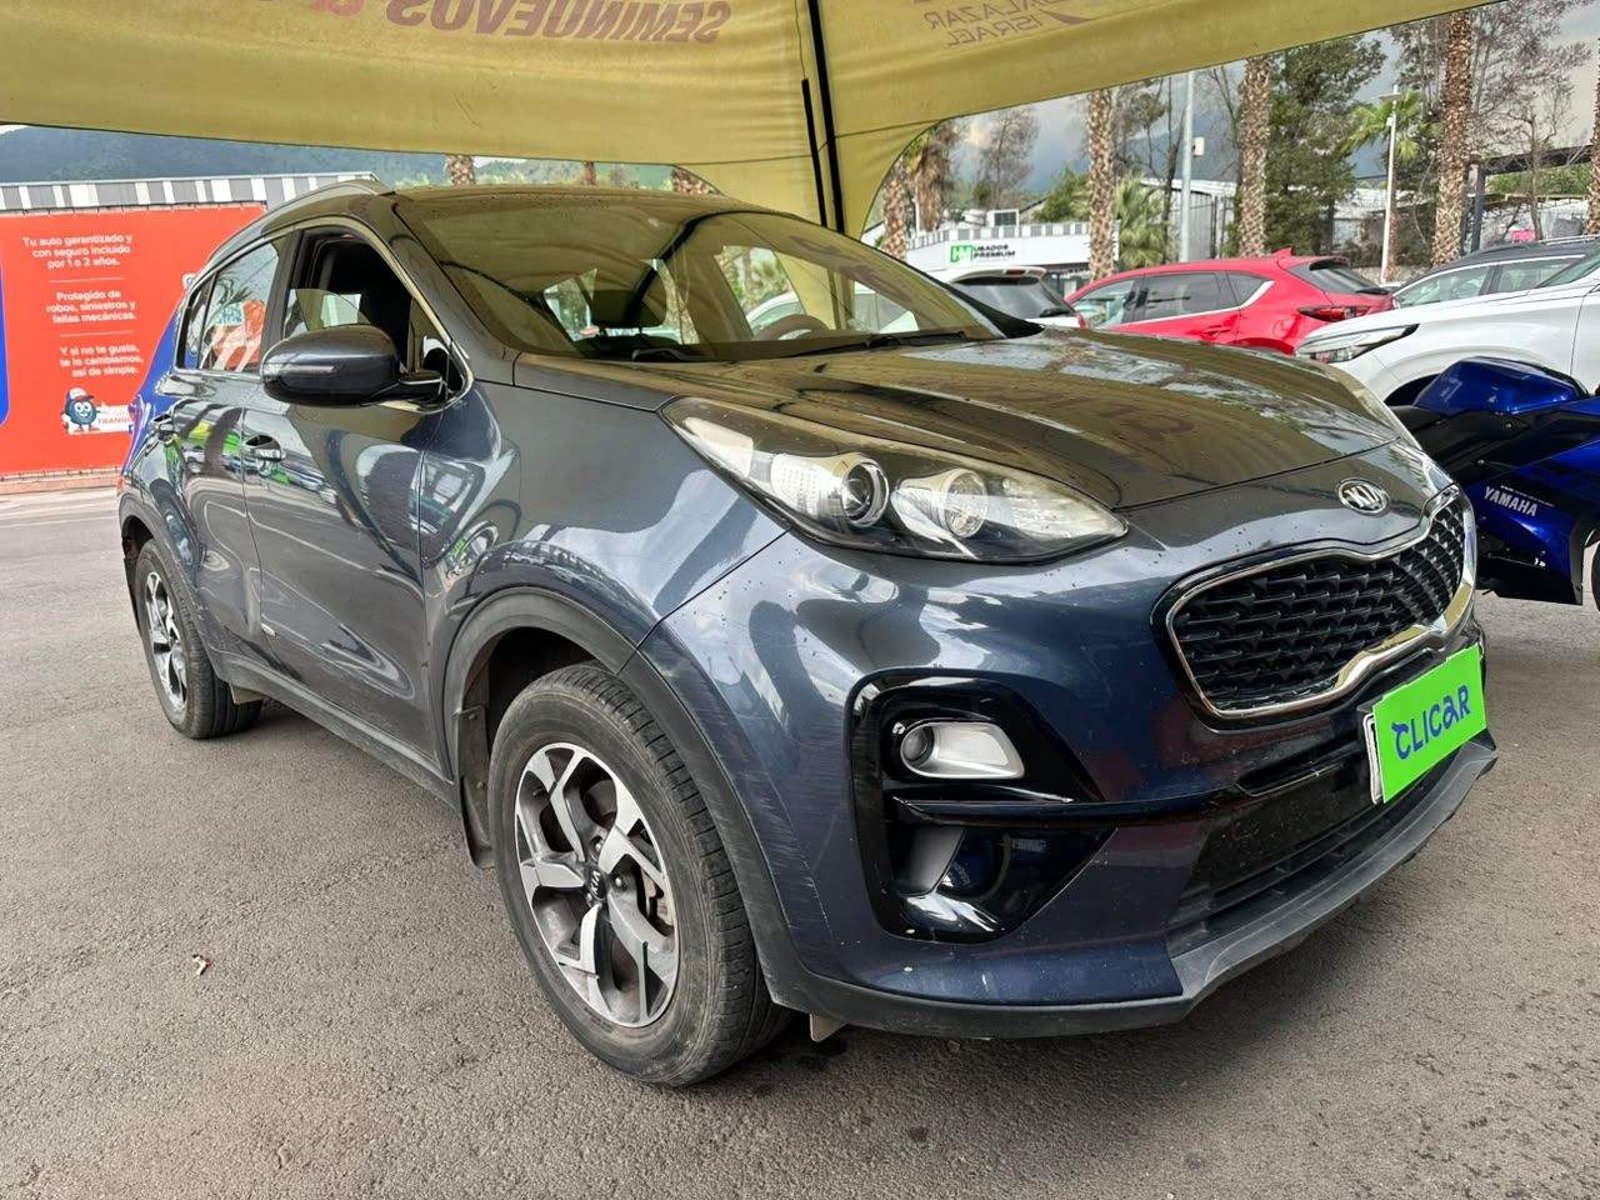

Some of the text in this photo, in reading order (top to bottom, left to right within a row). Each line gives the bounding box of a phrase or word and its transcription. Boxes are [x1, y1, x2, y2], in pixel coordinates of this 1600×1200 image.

[22, 234, 133, 247] Tu auto garantizado y
[32, 245, 131, 259] con seguro incluido
[48, 259, 65, 270] por
[83, 256, 91, 267] 2
[56, 290, 121, 302] Protegido de
[80, 301, 128, 311] siniestros
[129, 301, 136, 311] y
[52, 313, 80, 324] fallas
[60, 346, 68, 355] Y
[69, 345, 79, 355] si
[81, 346, 94, 354] no
[95, 345, 107, 354] te
[60, 358, 71, 367] te
[72, 357, 83, 366] lo
[88, 366, 102, 376] de
[1484, 486, 1538, 517] YAMAHA
